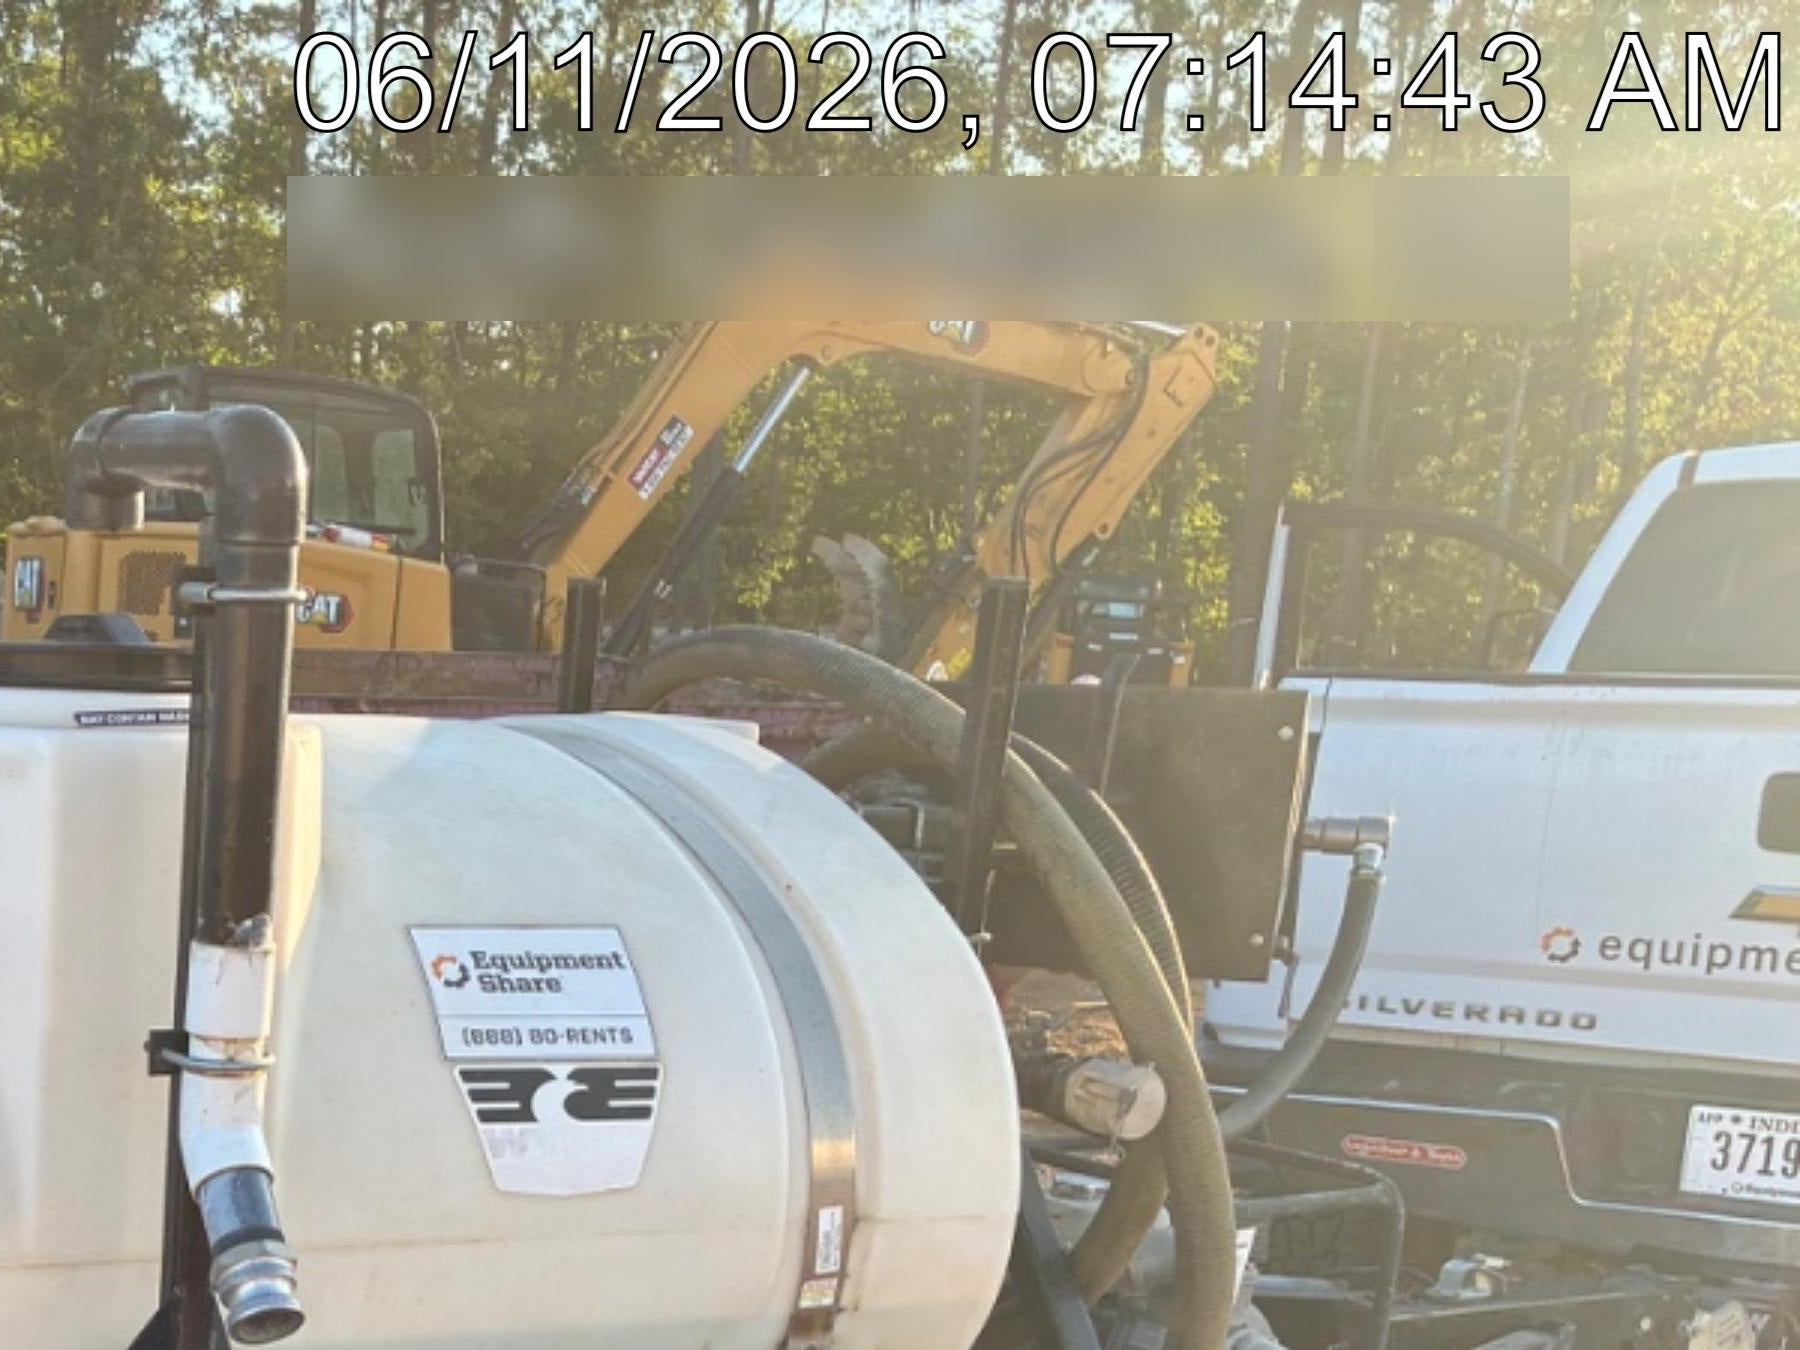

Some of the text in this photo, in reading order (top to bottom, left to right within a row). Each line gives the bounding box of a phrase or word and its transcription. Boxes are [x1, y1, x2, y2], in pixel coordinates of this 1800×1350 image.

[296, 593, 341, 624] CAT
[469, 950, 626, 973] Equipment
[1599, 932, 1800, 976] equipme
[477, 973, 562, 993] Share
[1343, 994, 1598, 1030] ILVERADO
[462, 1026, 634, 1047] (888) 80-RENTS
[1710, 1131, 1800, 1178] 3719
